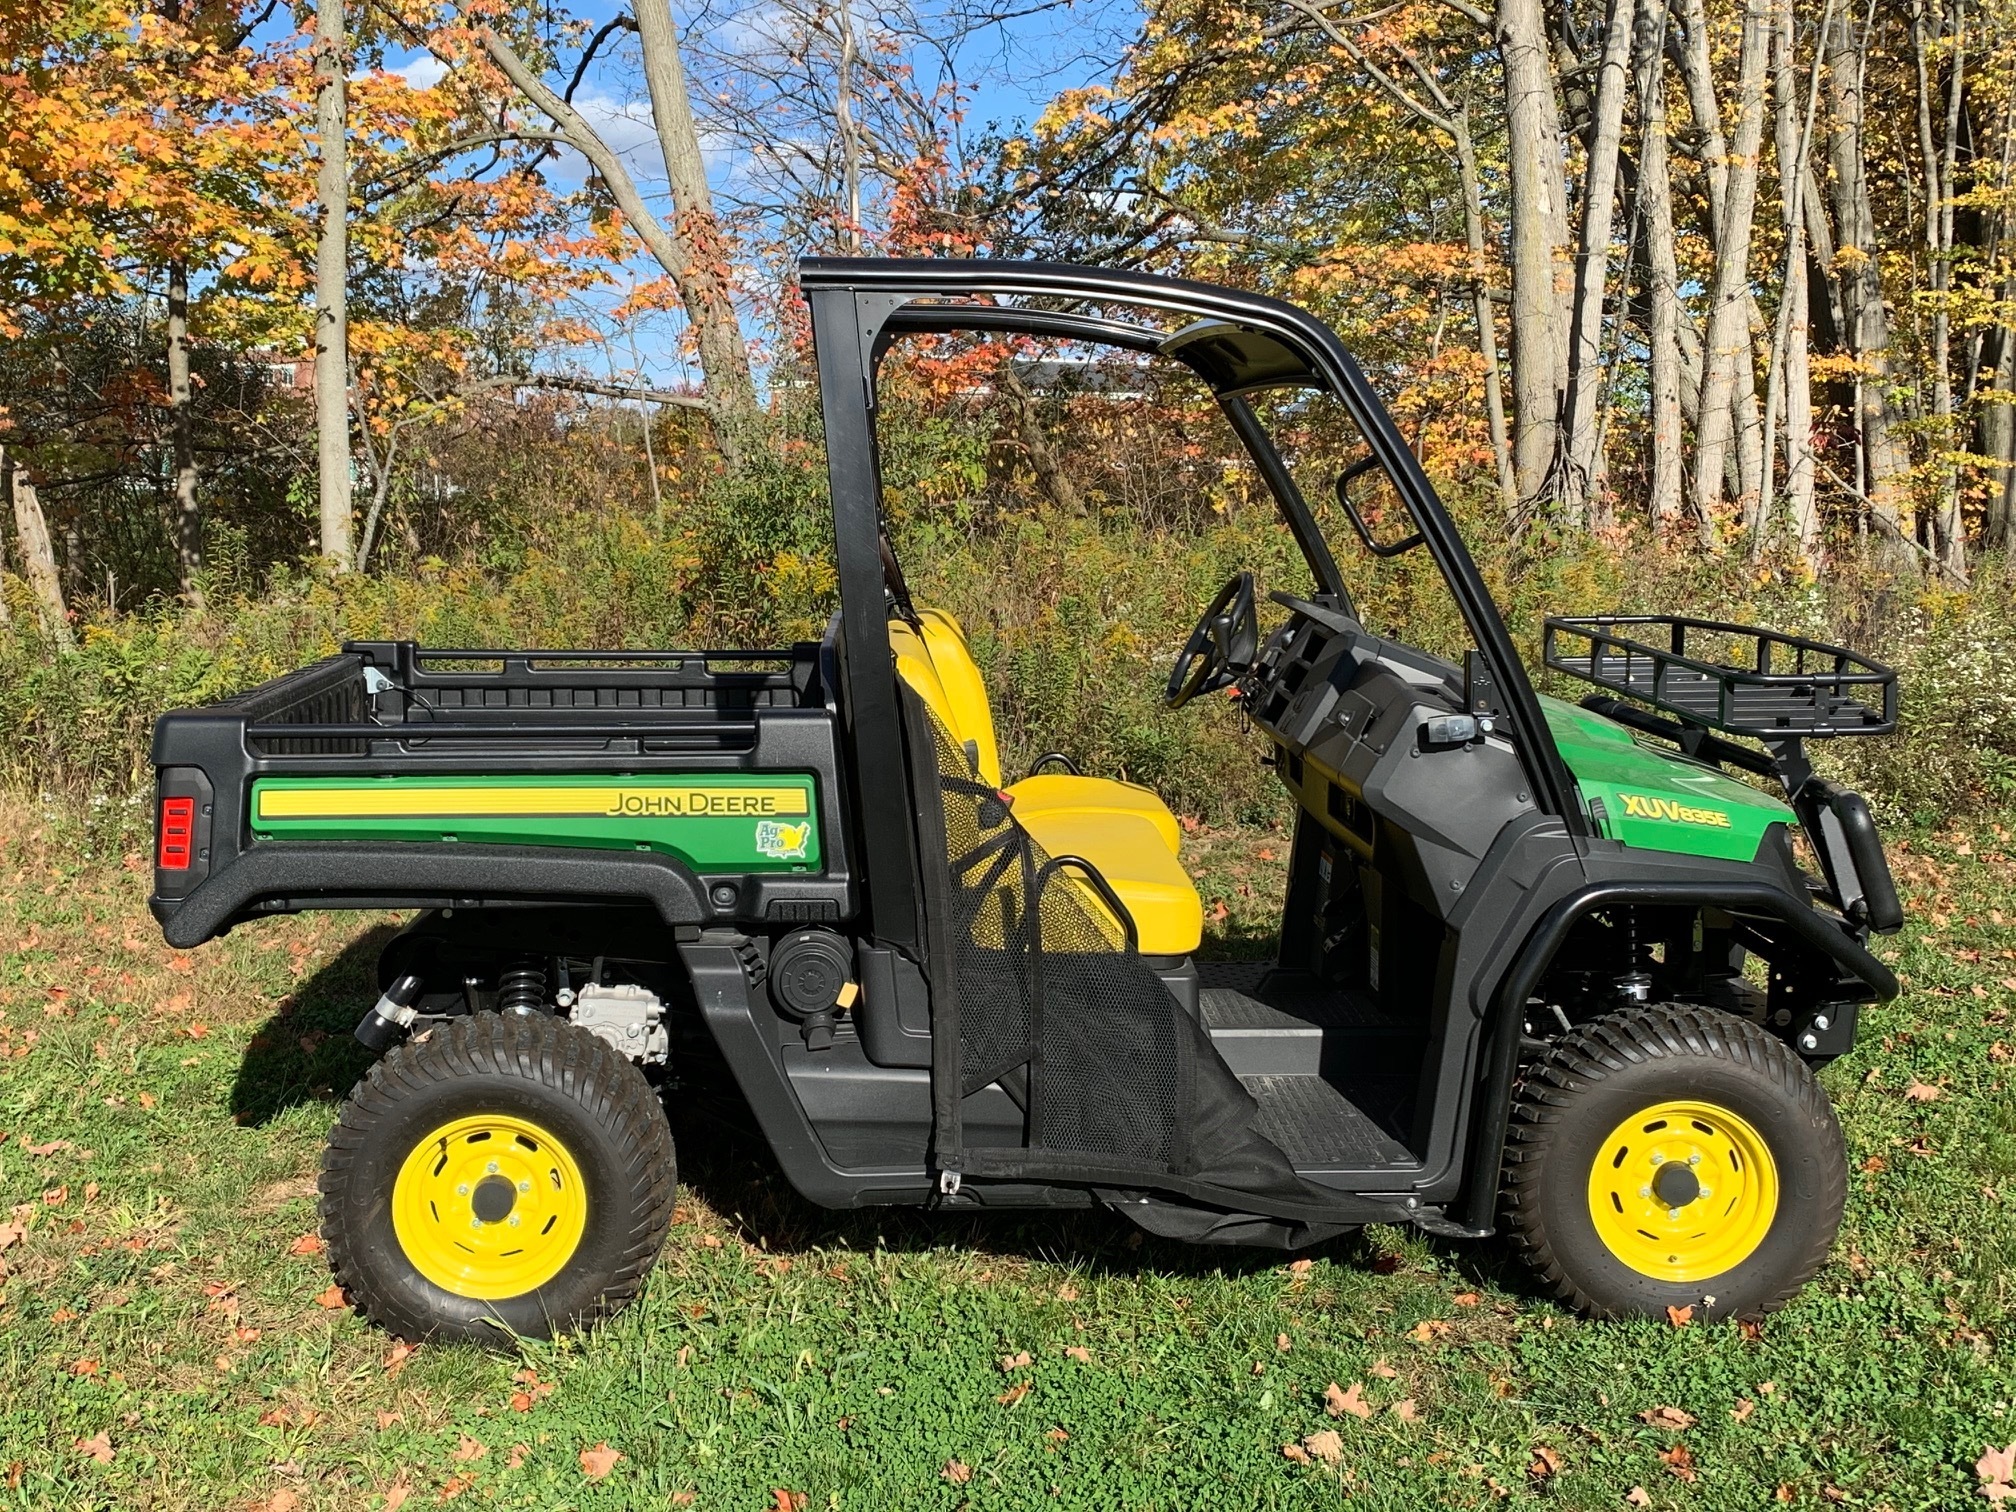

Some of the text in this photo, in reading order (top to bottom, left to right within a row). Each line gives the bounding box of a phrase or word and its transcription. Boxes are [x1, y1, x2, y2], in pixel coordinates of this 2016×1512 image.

[610, 793, 775, 812] JOHN DEERE
[760, 837, 784, 848] Pro
